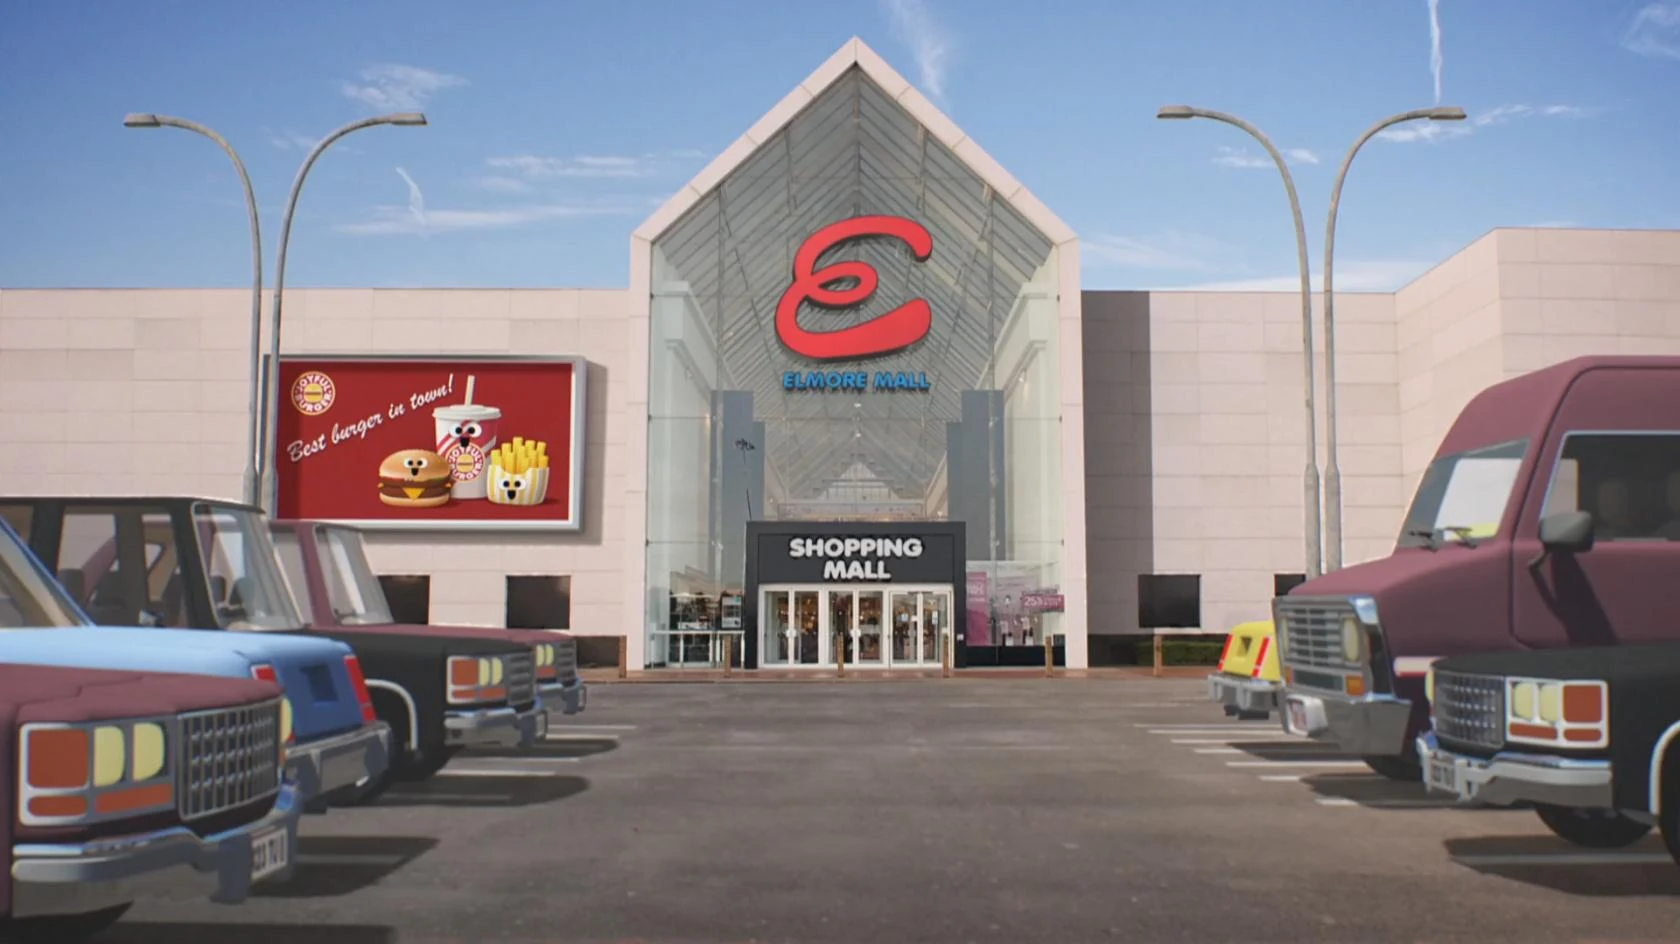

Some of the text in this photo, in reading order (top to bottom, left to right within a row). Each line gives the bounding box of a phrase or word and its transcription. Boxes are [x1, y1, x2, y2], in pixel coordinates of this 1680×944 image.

[775, 215, 933, 359] E
[295, 374, 332, 393] JOYFUL
[783, 371, 931, 390] ELMORE MALL
[294, 394, 332, 412] BURGER
[287, 373, 454, 462] Best burger in town!
[789, 538, 923, 557] SHOPPING
[823, 560, 892, 579] MALL
